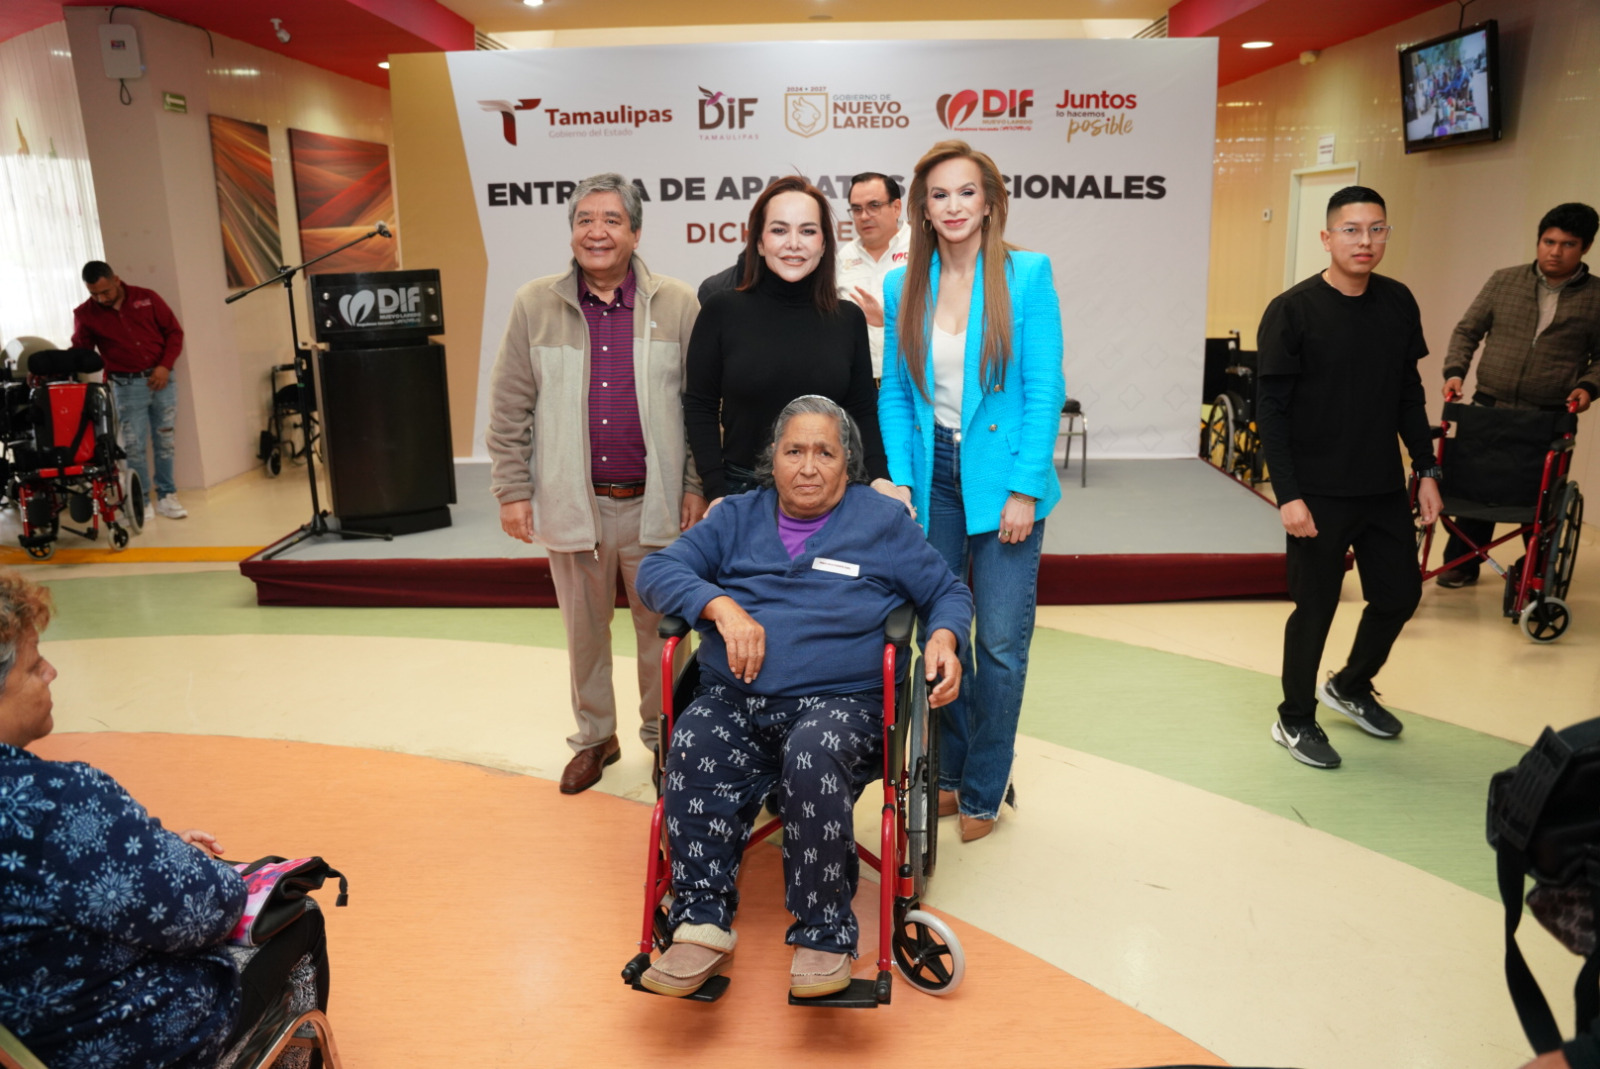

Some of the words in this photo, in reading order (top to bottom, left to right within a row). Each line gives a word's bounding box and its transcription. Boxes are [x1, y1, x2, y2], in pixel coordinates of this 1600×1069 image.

[833, 101, 902, 114] NUEVO
[982, 89, 1034, 118] DIF
[1055, 89, 1137, 109] Juntos
[544, 105, 673, 128] Tamaulipas
[833, 115, 910, 129] LAREDO
[1067, 110, 1105, 118] hacemos
[548, 130, 587, 139] Gobierno
[589, 128, 602, 137] del
[604, 128, 633, 137] Estado
[1067, 112, 1134, 143] posible
[660, 177, 706, 202] DE
[377, 286, 421, 314] DIF
